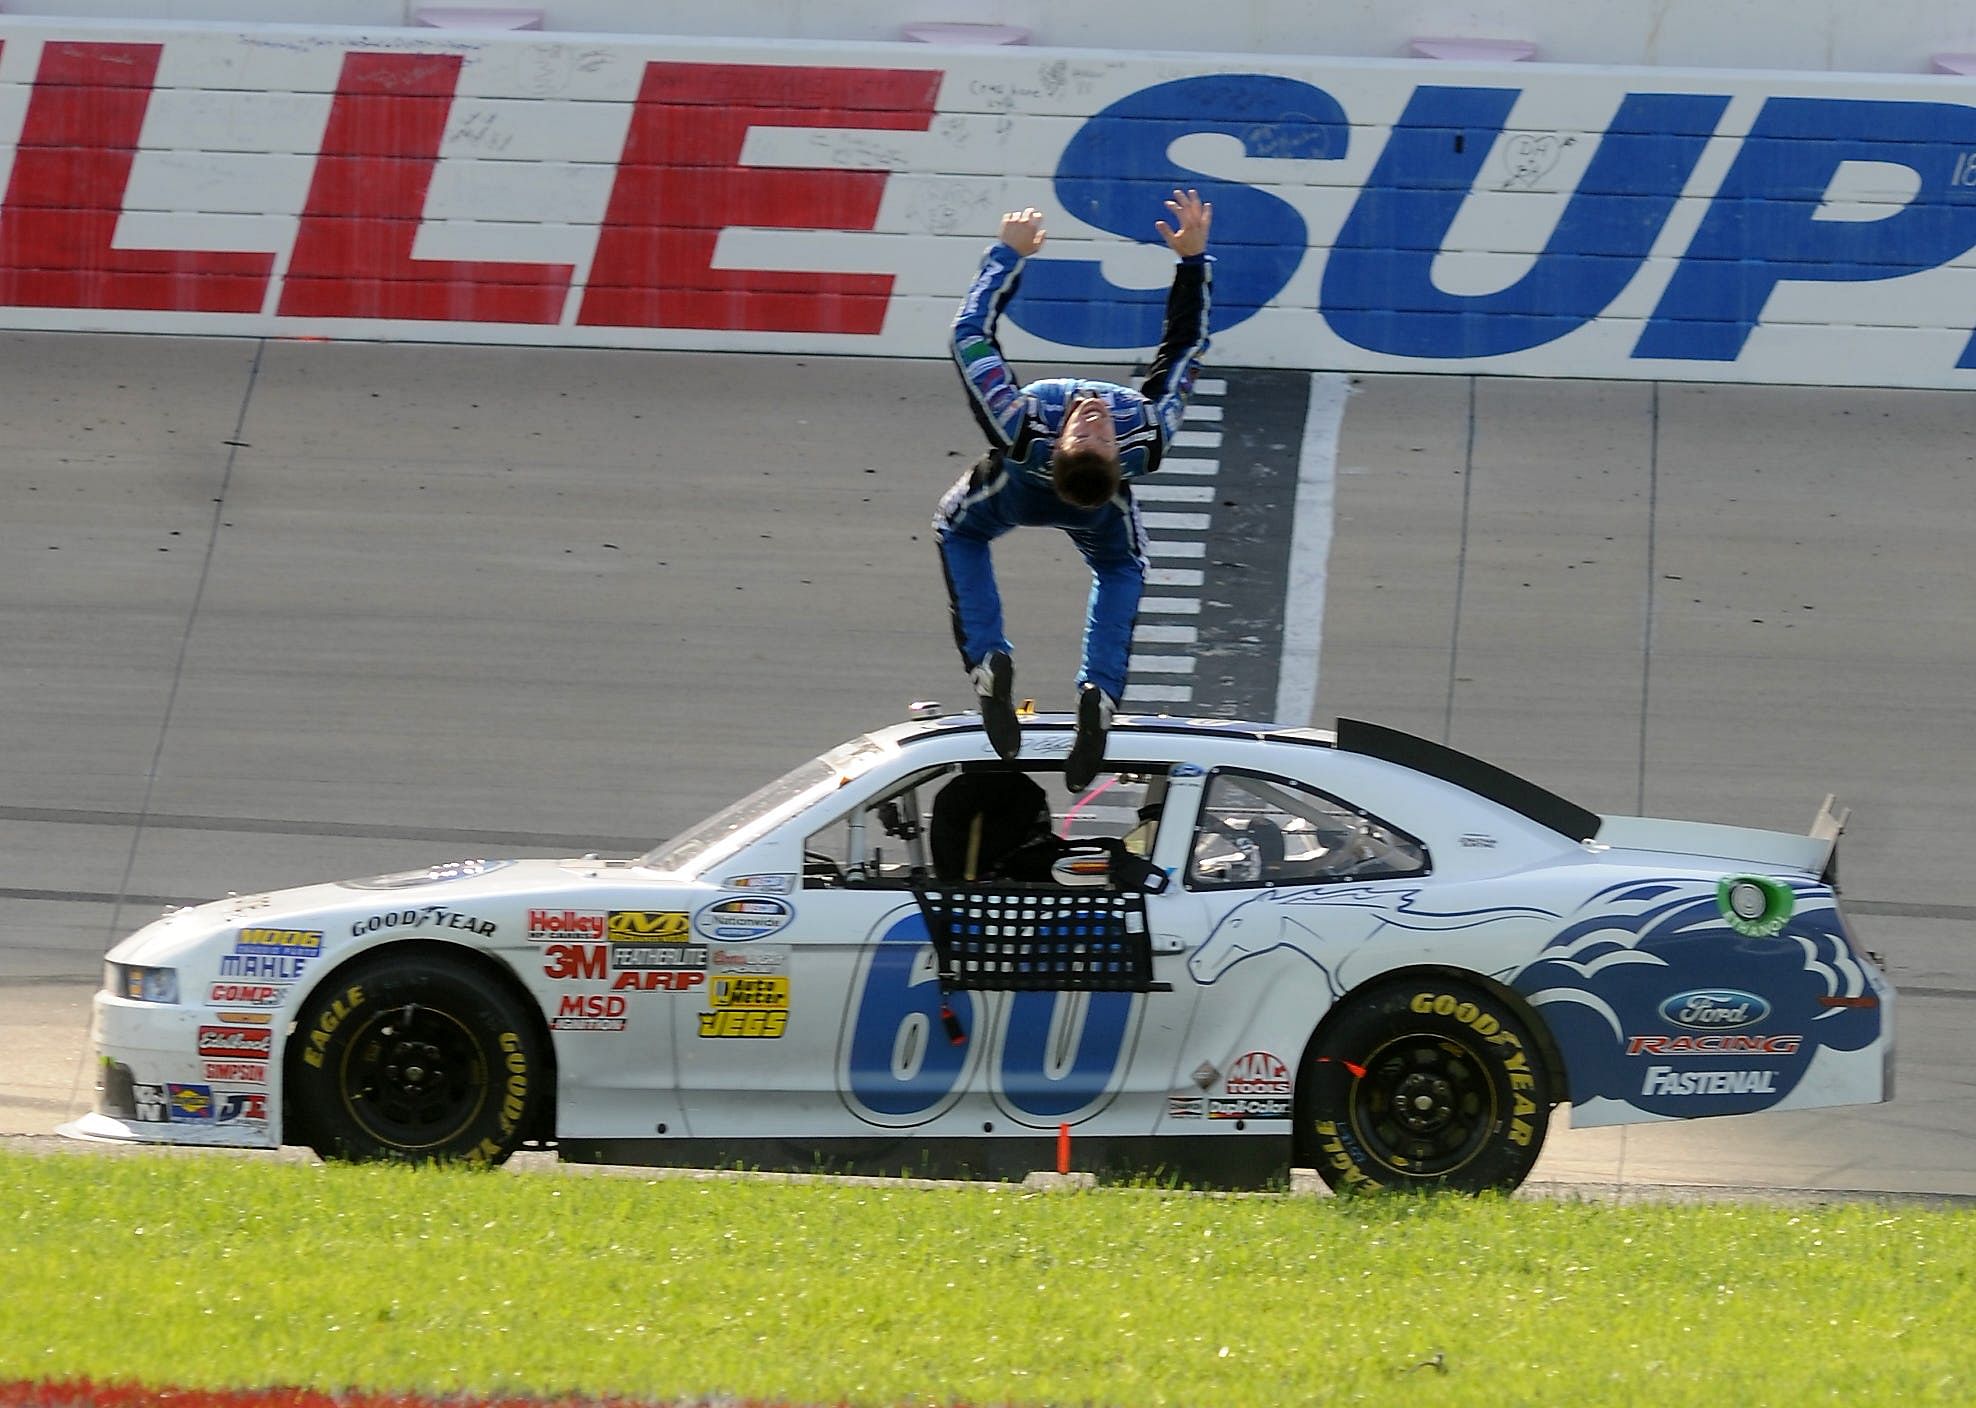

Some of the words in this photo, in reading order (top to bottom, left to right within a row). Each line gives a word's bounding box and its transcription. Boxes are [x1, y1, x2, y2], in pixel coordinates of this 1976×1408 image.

[0, 40, 945, 335] LLE
[1004, 73, 1976, 369] SUP
[352, 905, 497, 937] GOODYEAR
[528, 910, 605, 938] Holley
[714, 915, 781, 928] Nationwide
[239, 929, 322, 948] MOOG
[220, 955, 306, 978] MAHLE
[544, 944, 607, 980] 3M
[211, 984, 273, 1002] COMP
[611, 971, 705, 991] ARP
[734, 979, 776, 992] Auto
[559, 994, 627, 1018] MSD
[731, 991, 784, 1004] Meter
[1679, 994, 1750, 1023] Ford
[698, 1009, 790, 1038] JEGS
[848, 905, 1140, 1120] 60
[303, 984, 366, 1069] EAGLE
[1625, 1034, 1804, 1056] RACING
[205, 1062, 265, 1081] SIMPSON
[1229, 1054, 1287, 1081] MAC
[1410, 992, 1537, 1148] GOODYEAR
[1227, 1083, 1290, 1094] TOOLS
